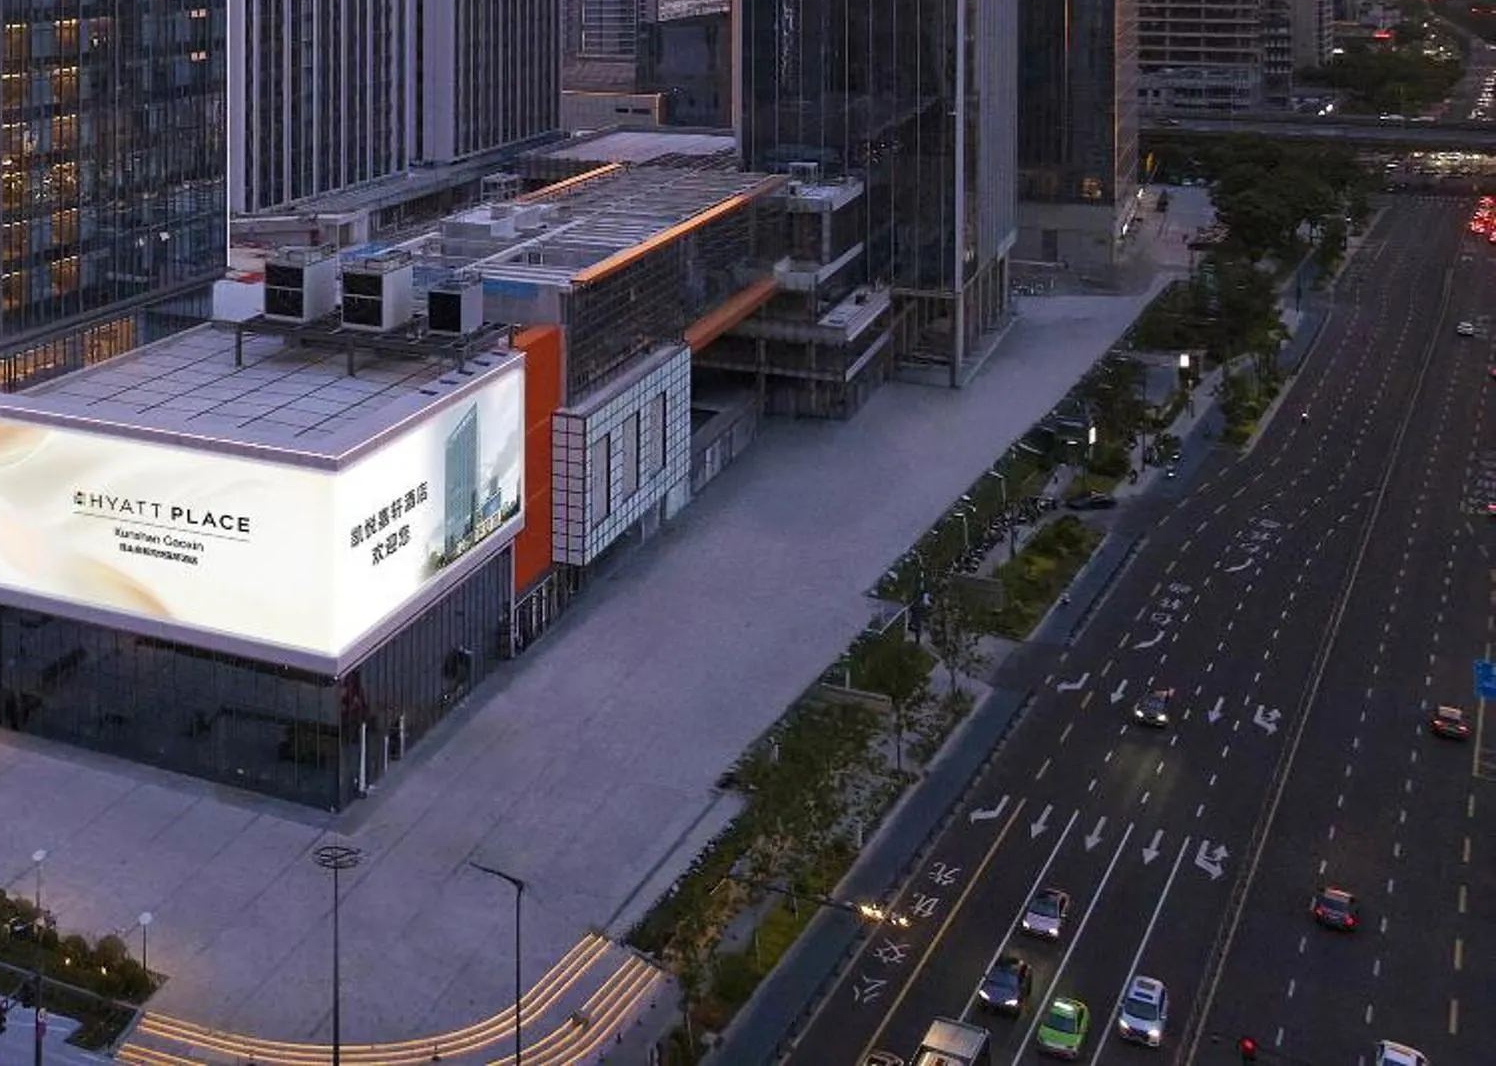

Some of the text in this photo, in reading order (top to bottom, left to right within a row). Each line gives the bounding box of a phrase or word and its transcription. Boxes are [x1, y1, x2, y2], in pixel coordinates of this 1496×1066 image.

[90, 493, 251, 533] HYATT PLACE
[350, 480, 428, 548] 凯悦嘉轩酒店
[371, 524, 412, 566] 欢迎您
